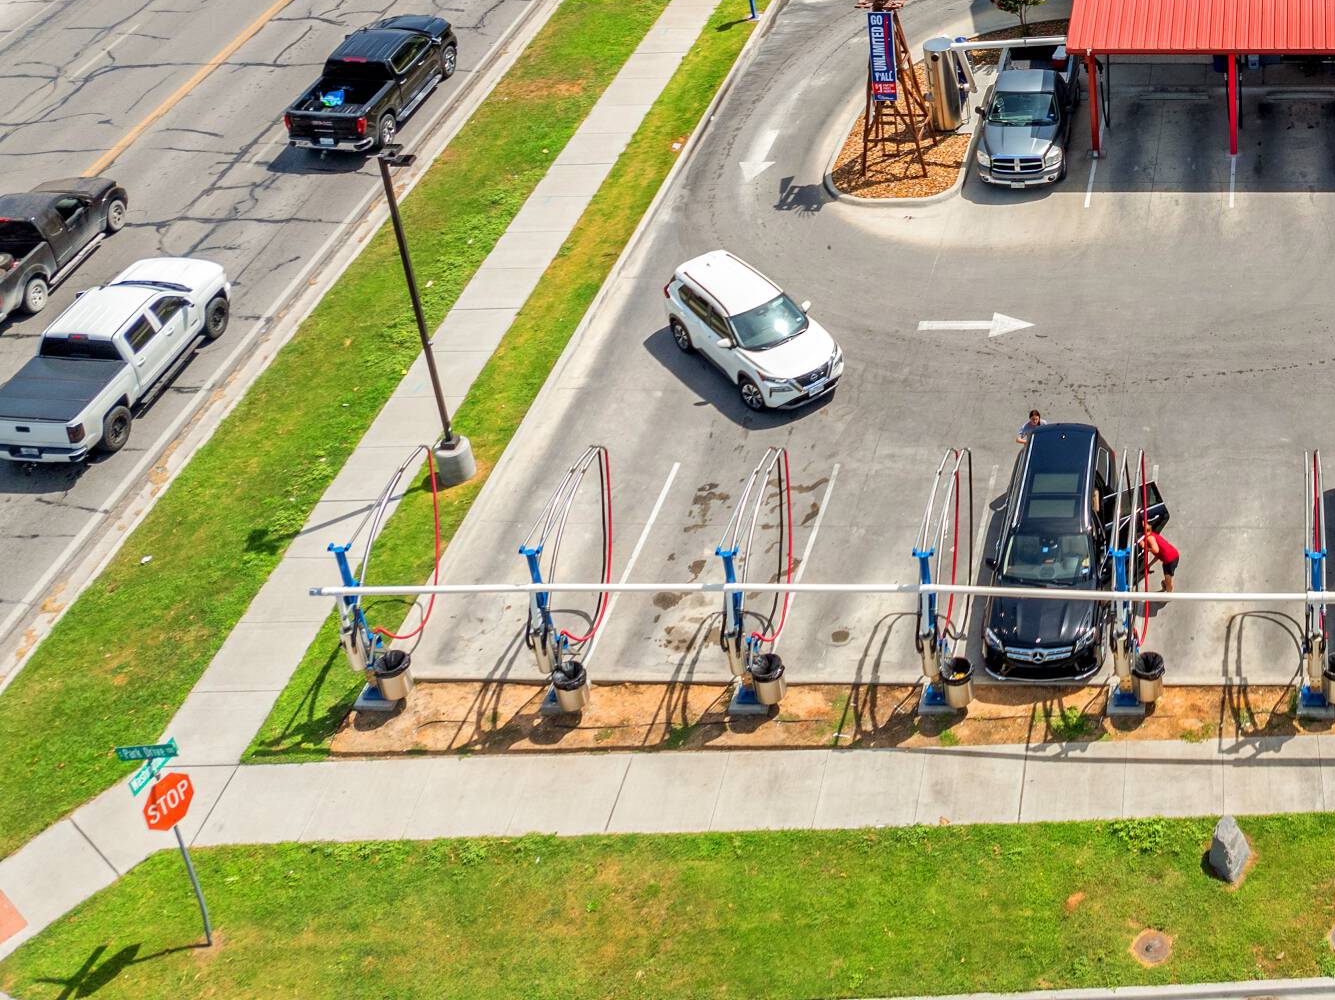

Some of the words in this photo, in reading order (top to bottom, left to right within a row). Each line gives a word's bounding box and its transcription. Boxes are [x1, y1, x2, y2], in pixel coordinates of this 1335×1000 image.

[870, 14, 883, 26] GO
[871, 26, 886, 72] UNLIMITED
[122, 748, 142, 759] Park
[147, 779, 189, 824] STOP
